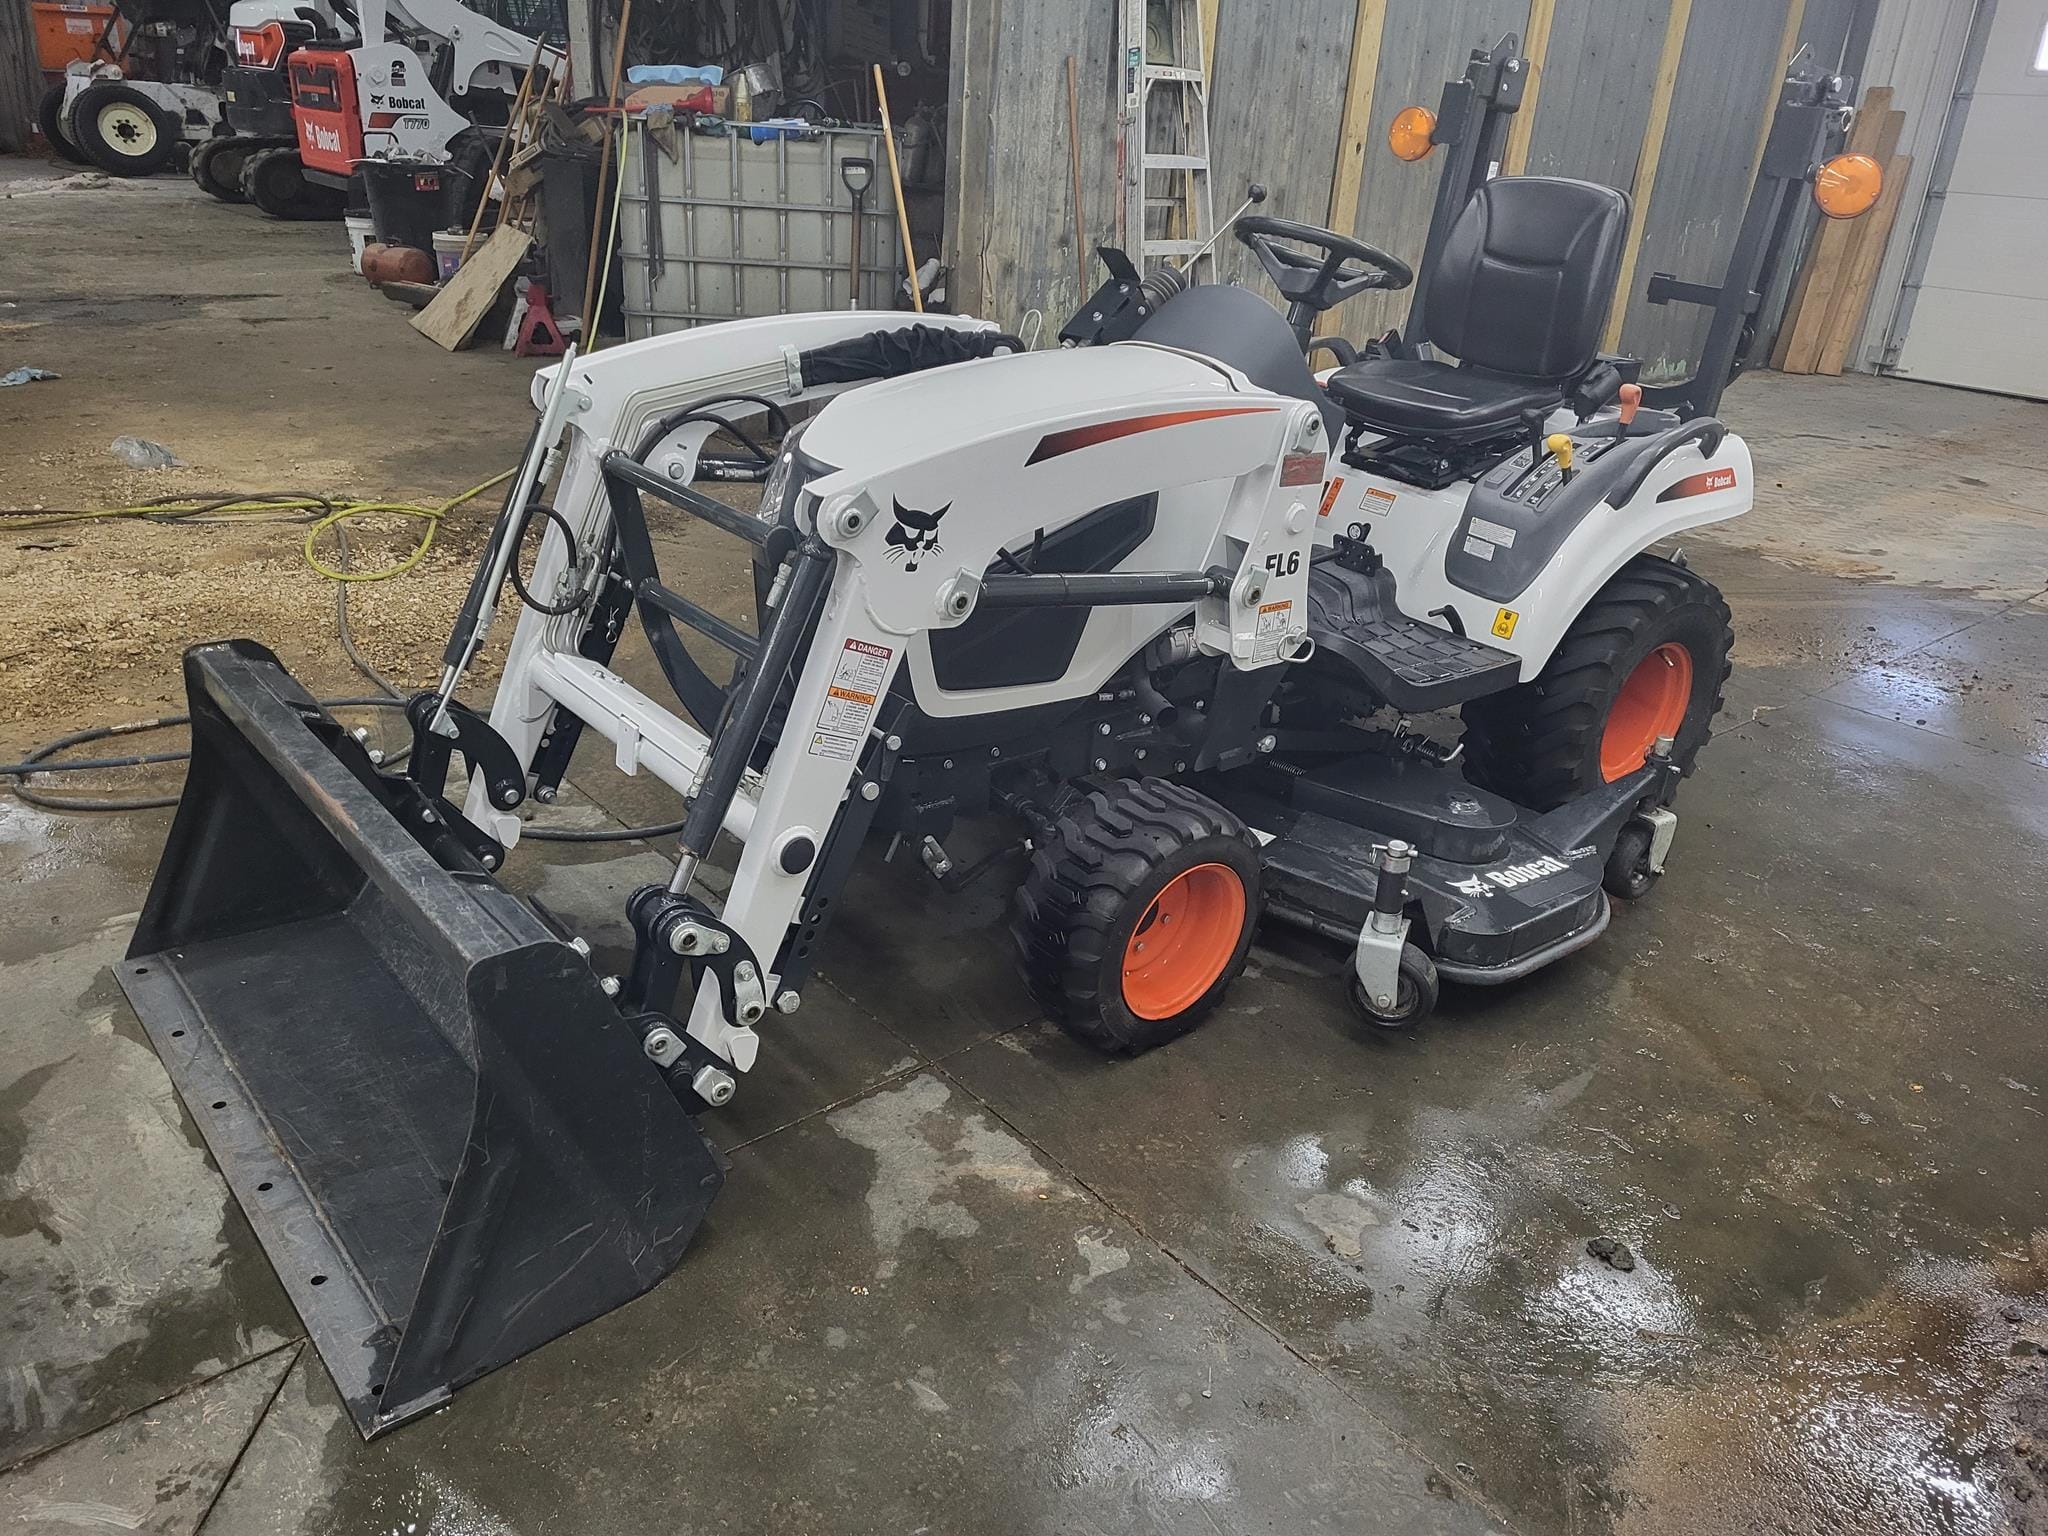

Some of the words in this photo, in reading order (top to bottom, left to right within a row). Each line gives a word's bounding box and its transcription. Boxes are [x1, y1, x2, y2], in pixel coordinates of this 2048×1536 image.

[388, 96, 426, 109] Bobcat
[403, 117, 430, 129] T770
[314, 125, 341, 152] Bobcat
[1714, 474, 1732, 487] Bobcat
[1265, 550, 1300, 577] FL6
[858, 643, 888, 657] DANGER
[840, 690, 872, 702] WARNING
[1485, 855, 1570, 887] Bobcat
